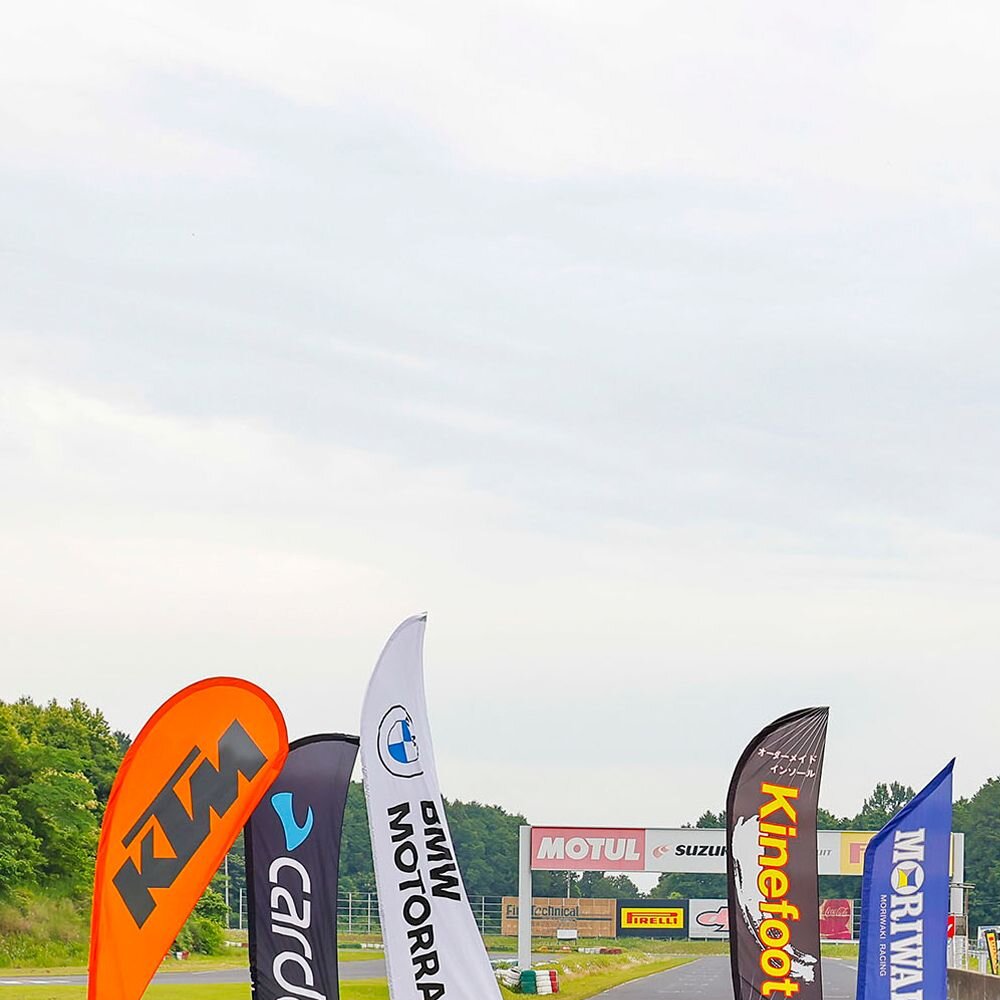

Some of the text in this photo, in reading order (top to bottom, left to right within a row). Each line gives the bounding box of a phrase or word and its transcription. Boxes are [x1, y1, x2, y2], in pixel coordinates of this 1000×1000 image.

[757, 747, 818, 764] オーダーメイド
[770, 764, 816, 778] インソール
[112, 719, 268, 928] KTM
[536, 837, 641, 861] MOTUL
[420, 800, 462, 901] BMW
[757, 782, 802, 998] Kinefoot
[626, 911, 678, 925] PIRELLI
[879, 894, 887, 977] MORIWAKI RACING
